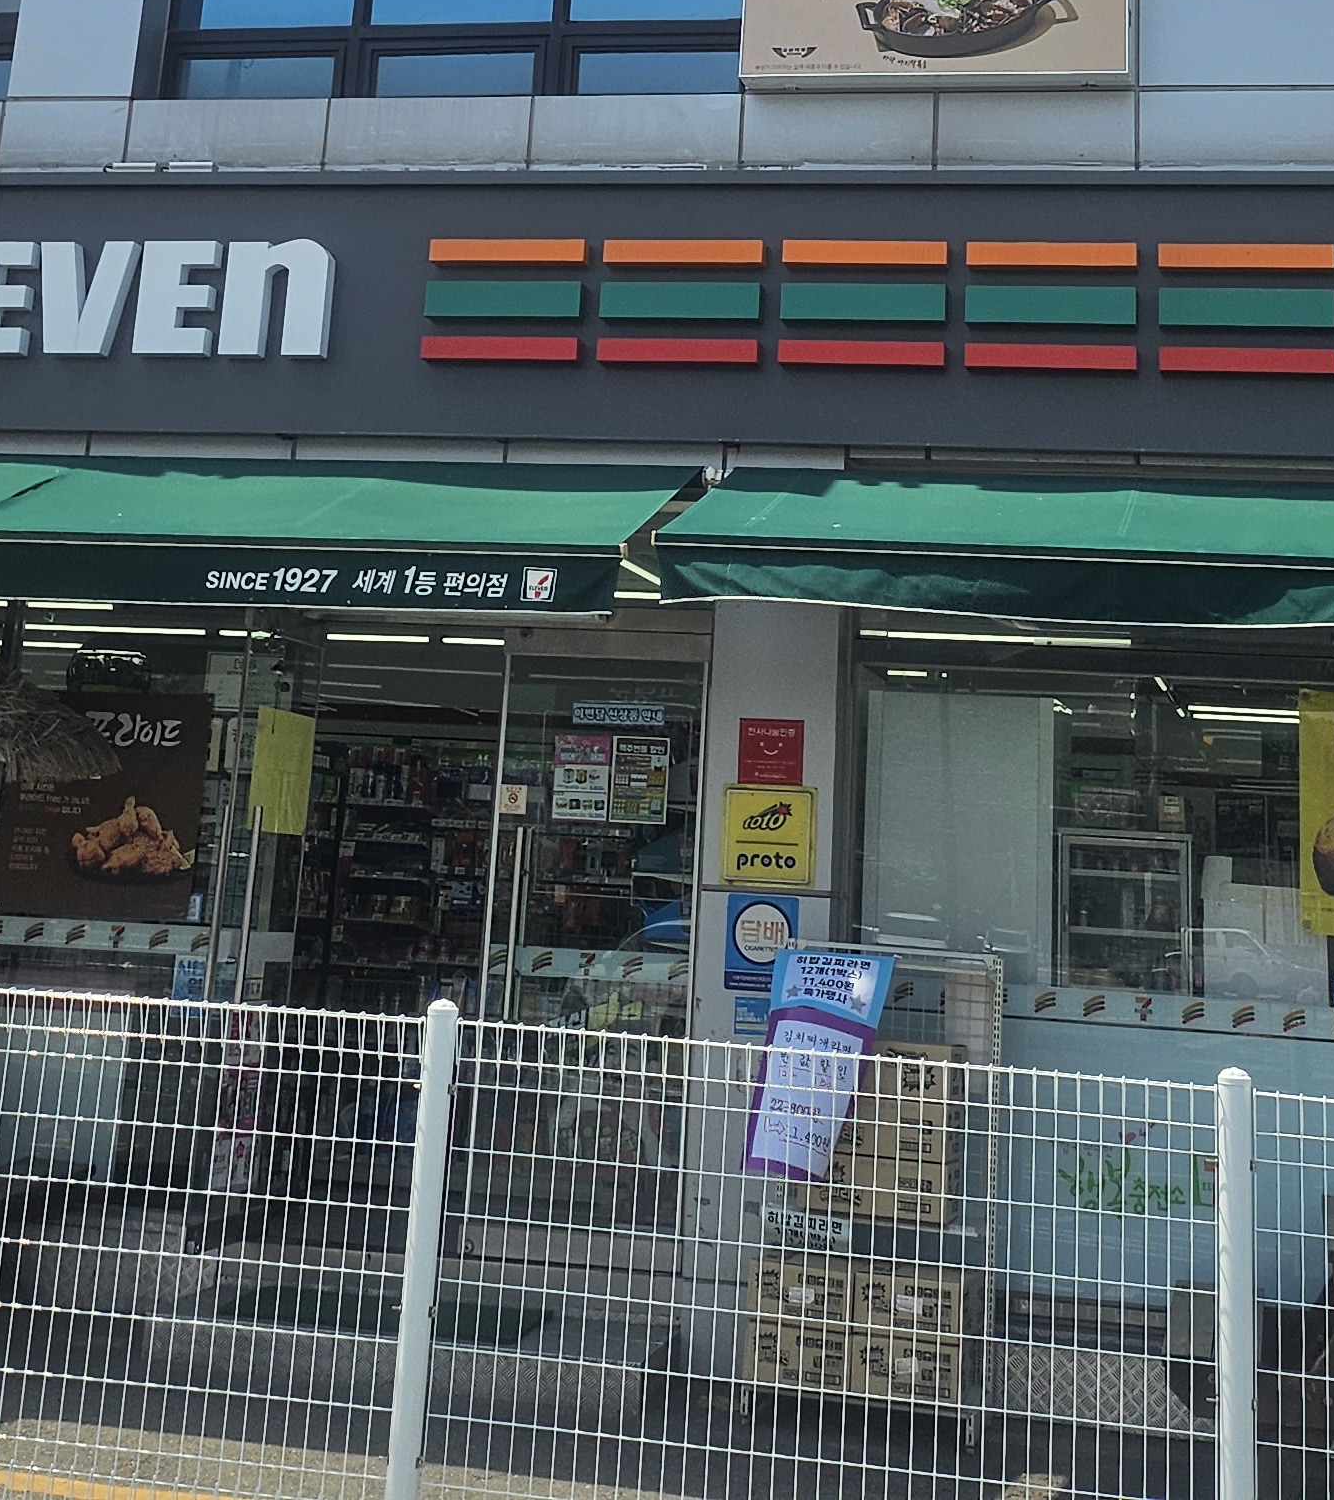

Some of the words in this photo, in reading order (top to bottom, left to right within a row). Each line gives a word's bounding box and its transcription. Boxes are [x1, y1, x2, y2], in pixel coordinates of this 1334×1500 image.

[351, 569, 398, 595] 세계
[402, 565, 437, 596] 1등
[442, 572, 509, 598] 편의점
[736, 852, 796, 871] proto
[740, 919, 785, 945] 담배
[802, 977, 855, 991] 11,400원
